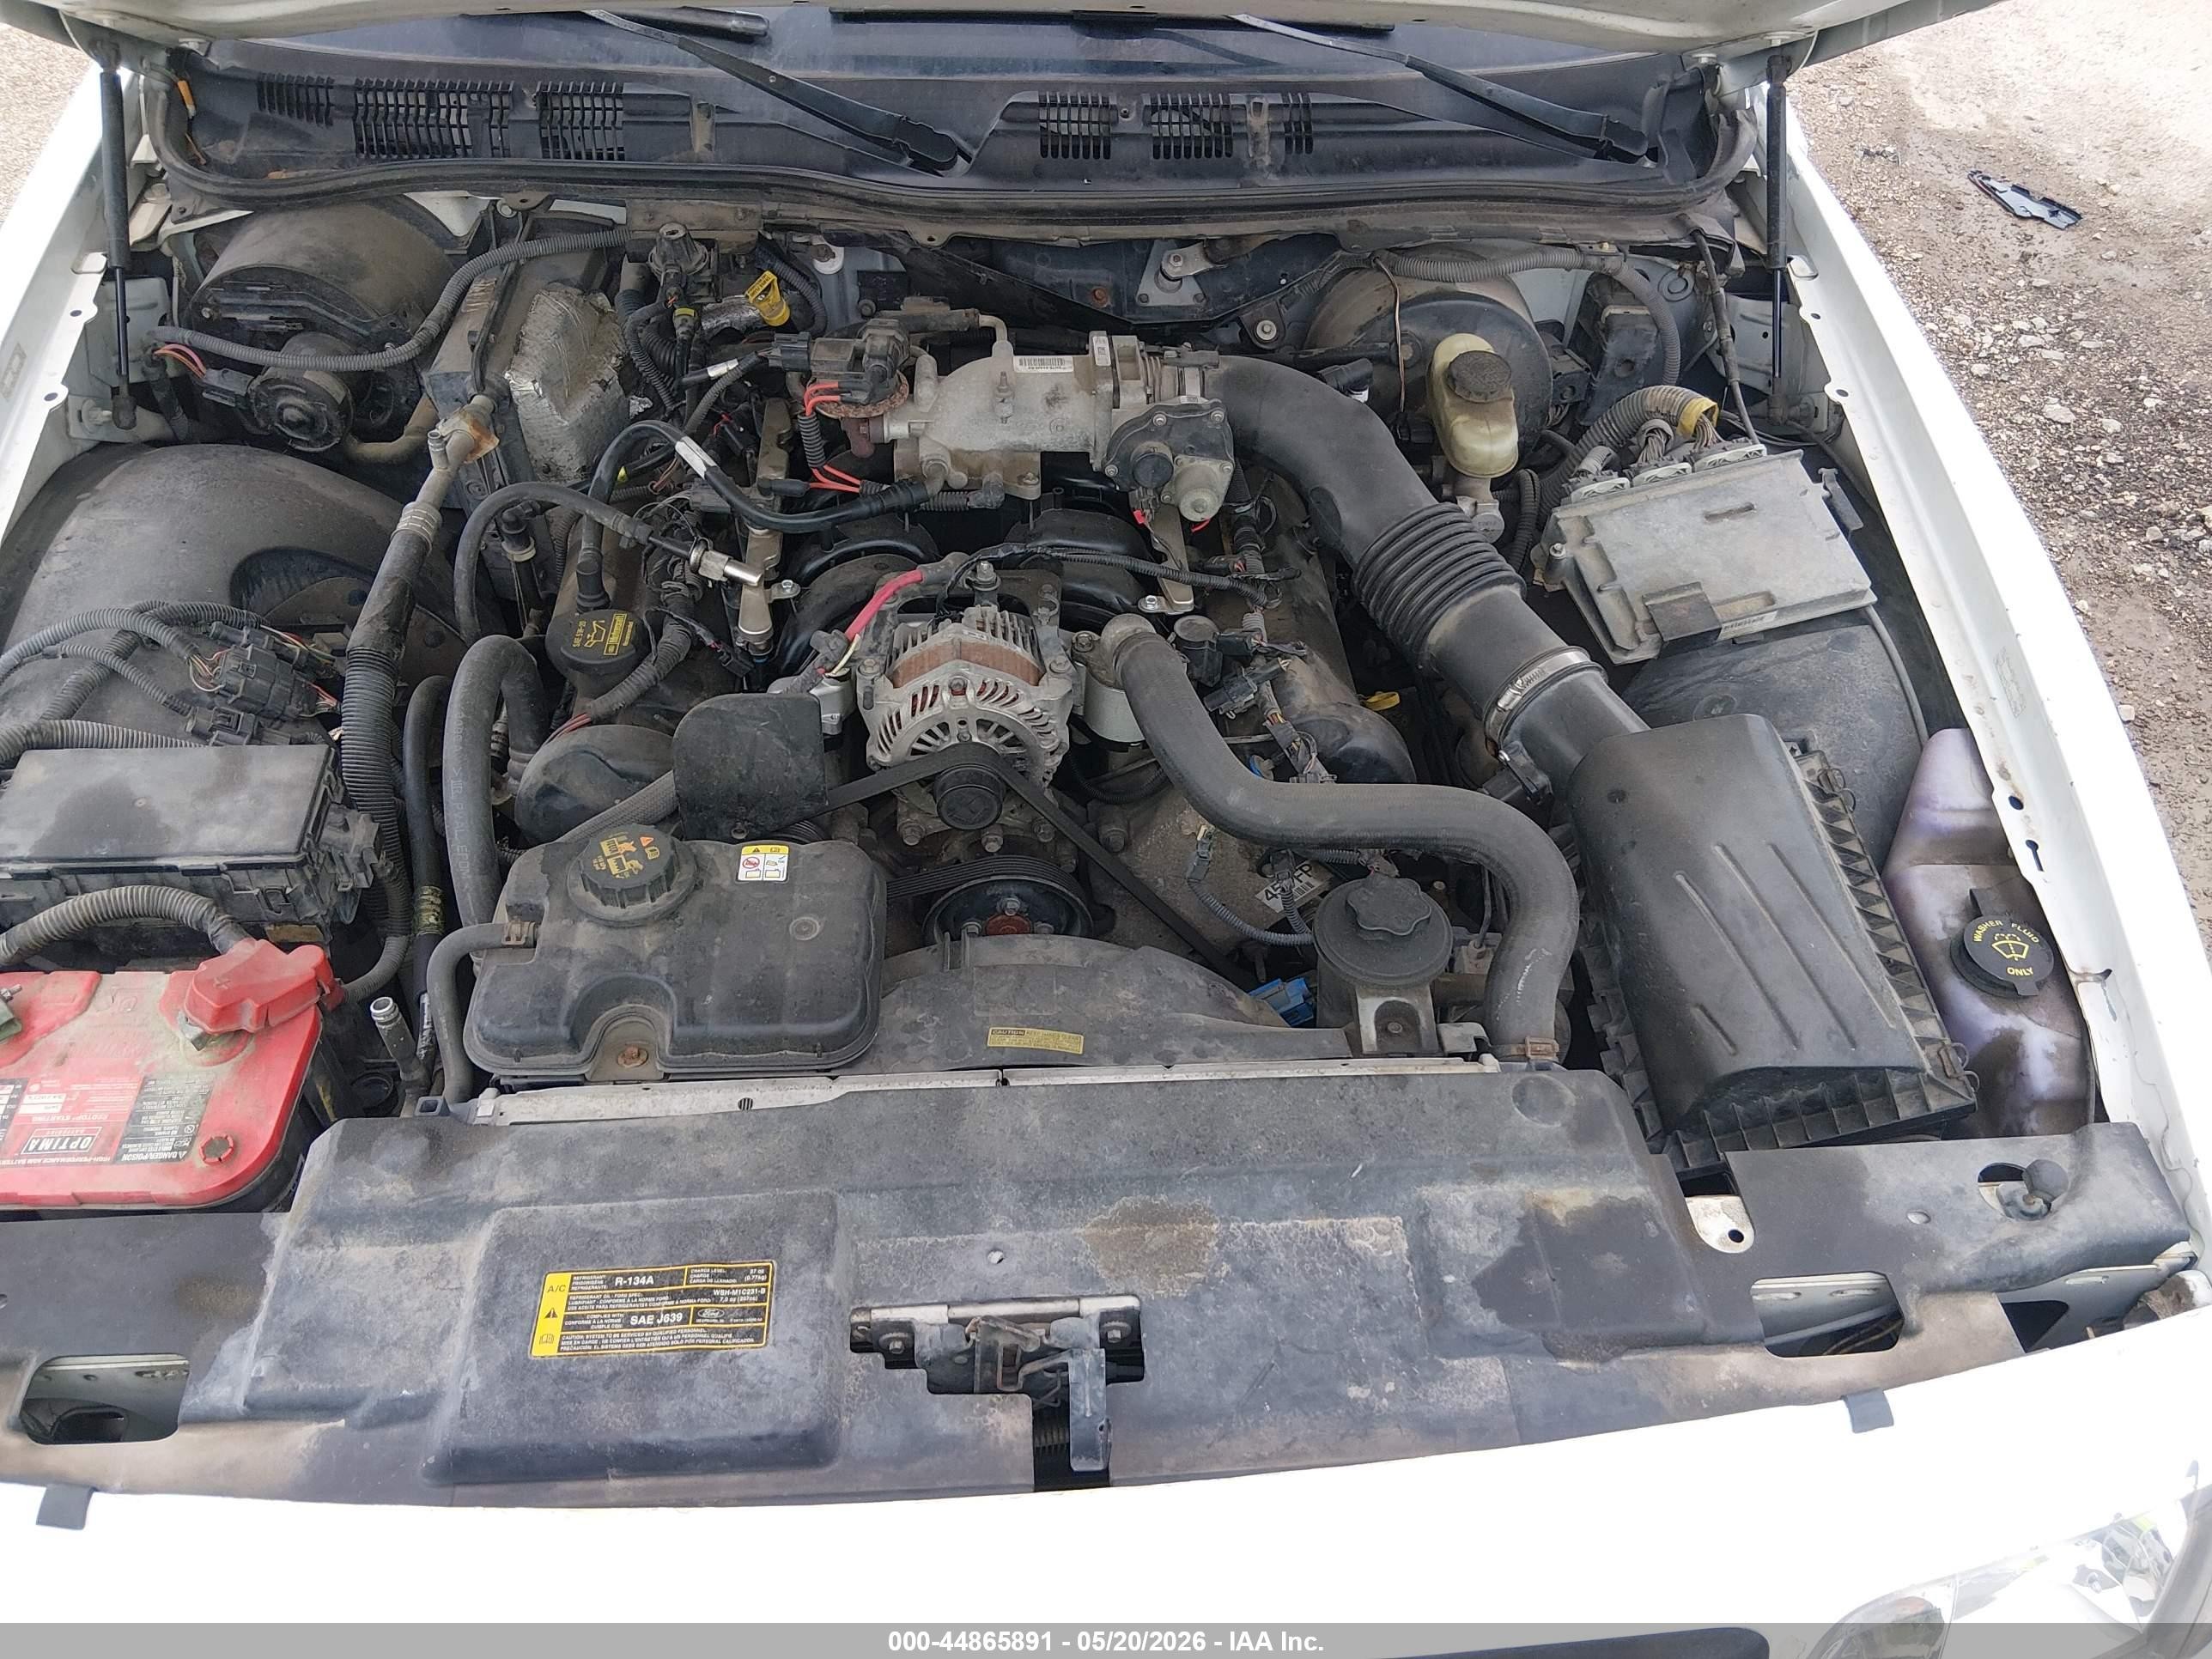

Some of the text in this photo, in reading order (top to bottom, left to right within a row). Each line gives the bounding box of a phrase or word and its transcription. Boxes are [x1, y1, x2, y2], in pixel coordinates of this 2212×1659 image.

[1264, 863, 1312, 901] 45FP
[1973, 920, 2040, 944] WASHER FLUID
[2007, 967, 2034, 976] ONLY
[28, 1137, 94, 1152] OPTIMA
[122, 1152, 178, 1162] DANGER/POISON
[615, 1275, 654, 1287] R-134A
[547, 1284, 567, 1293] A/C
[630, 1312, 684, 1325] SAE J639
